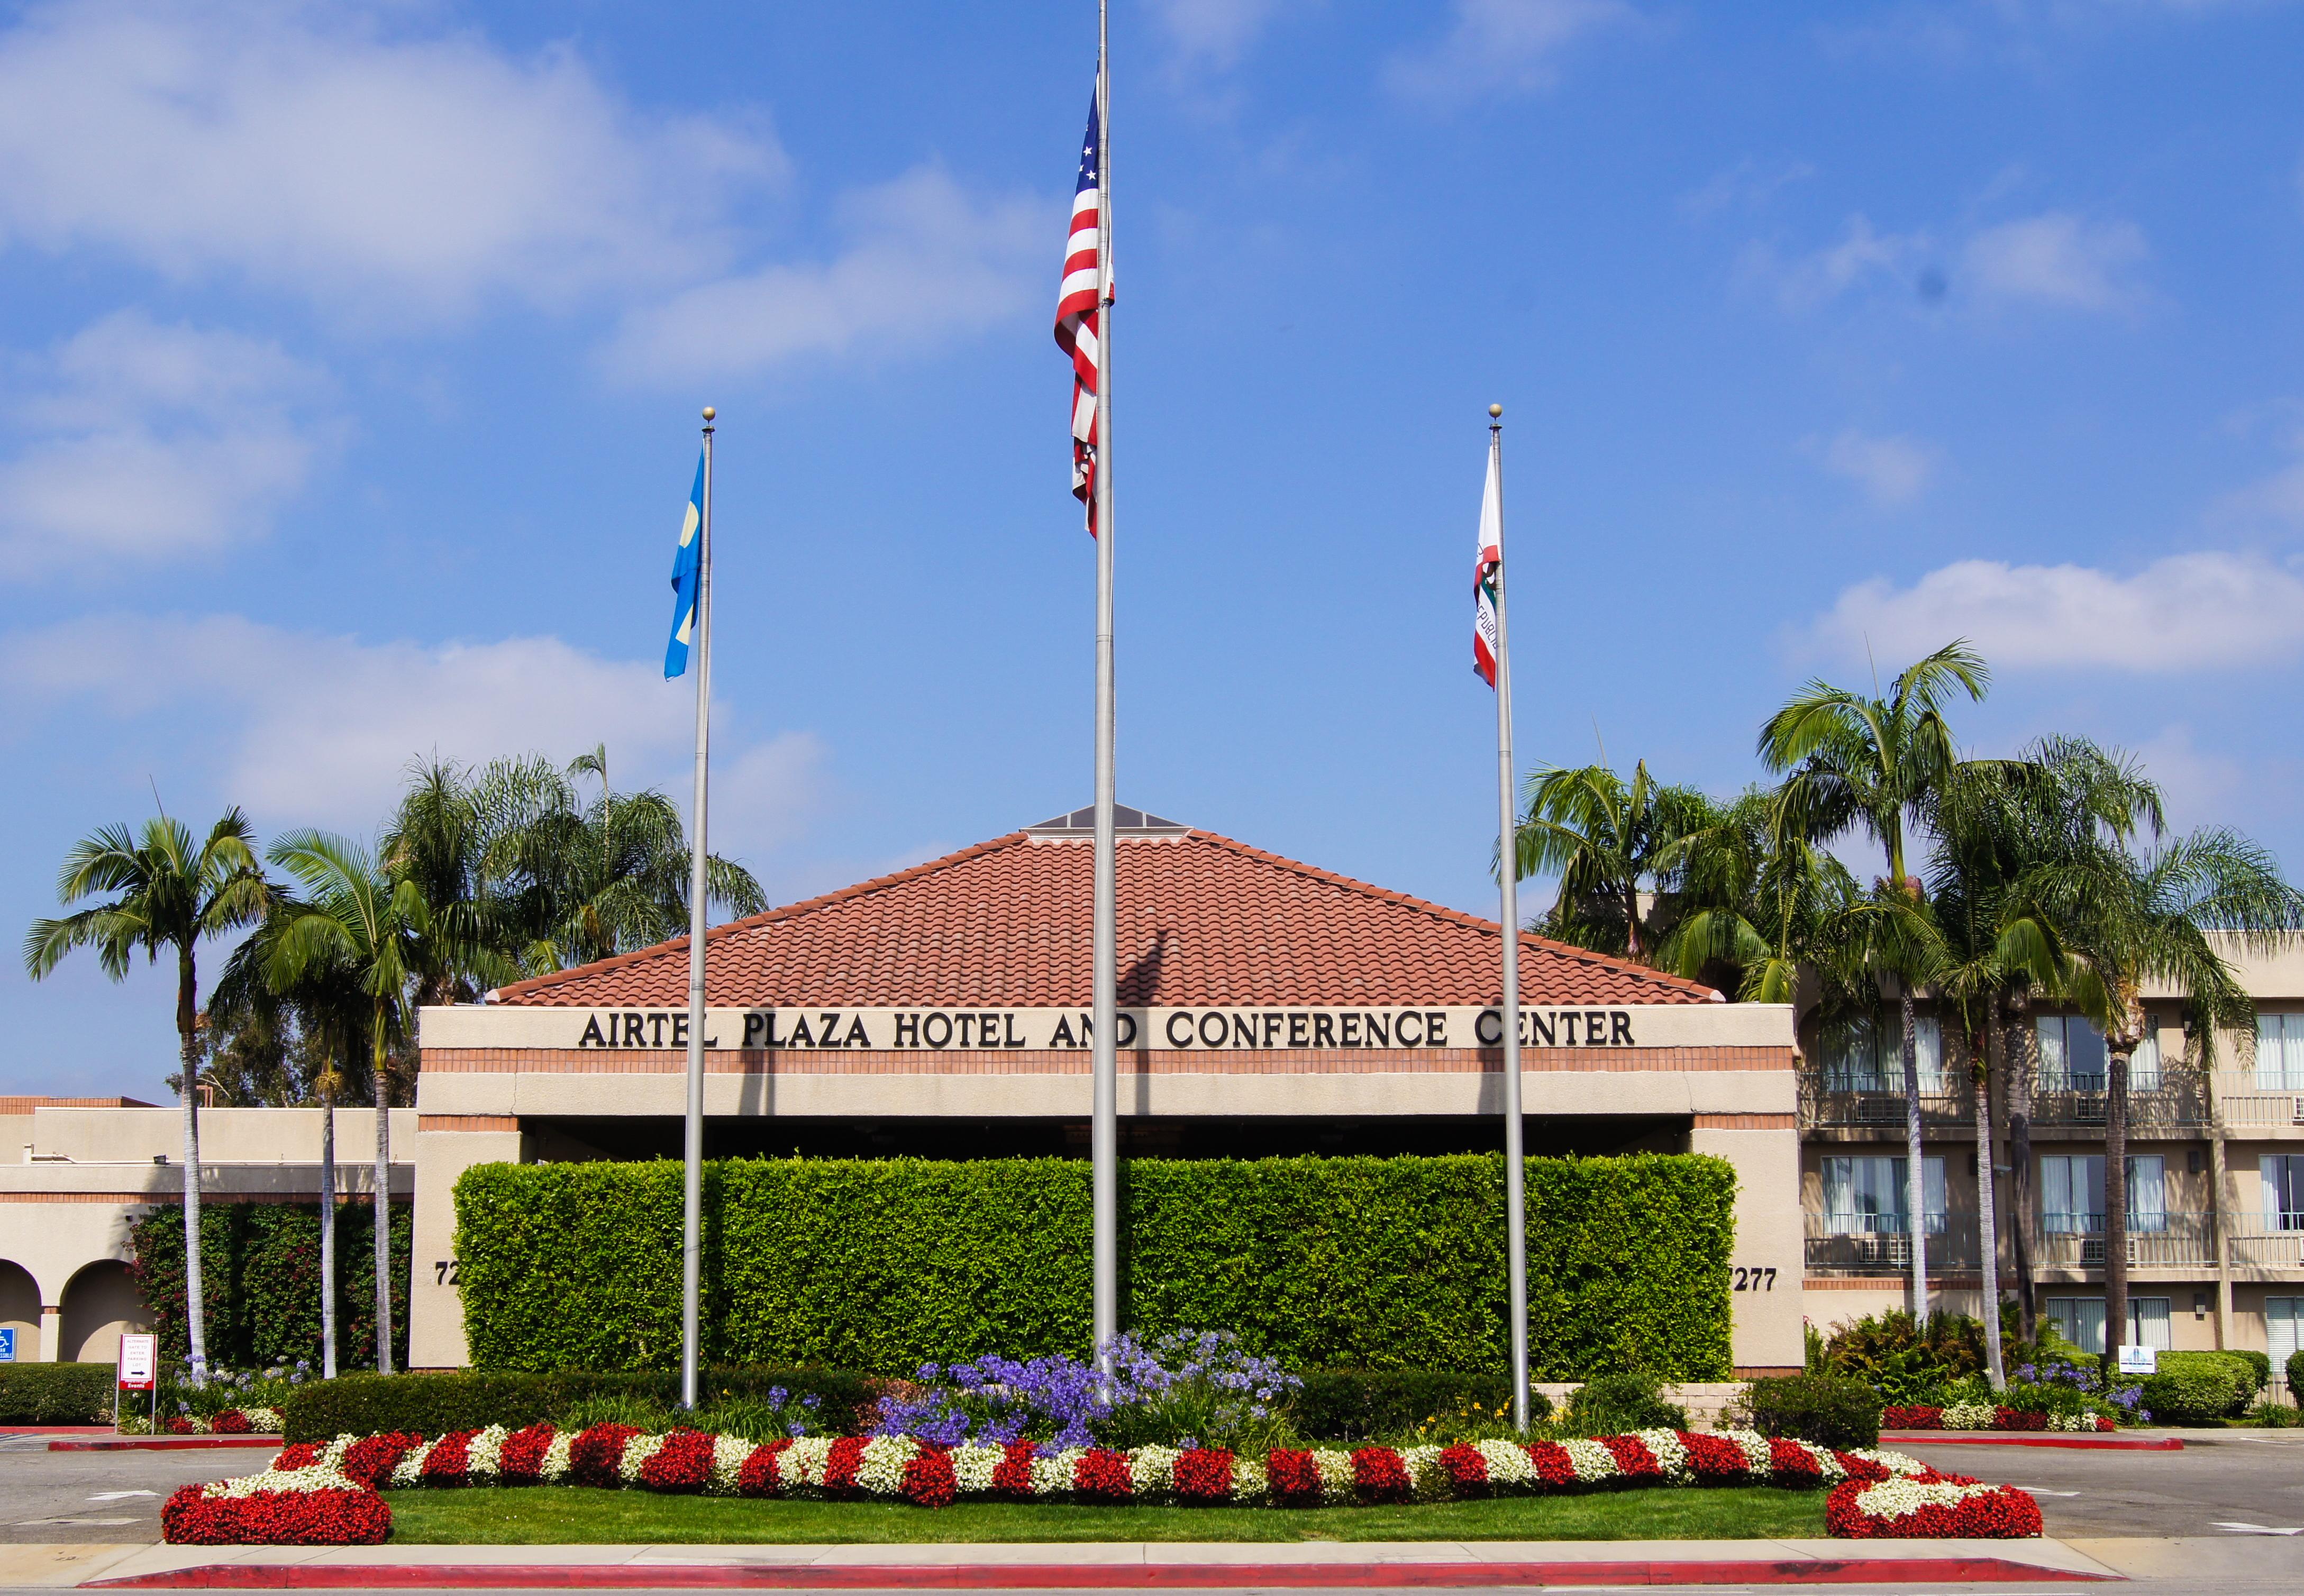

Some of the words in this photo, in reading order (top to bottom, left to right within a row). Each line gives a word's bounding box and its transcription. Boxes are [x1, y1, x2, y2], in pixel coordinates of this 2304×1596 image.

[742, 1013, 871, 1047] PLAZA
[894, 1012, 1026, 1047] HOTEL
[1166, 1011, 1448, 1047] CONFERENCE
